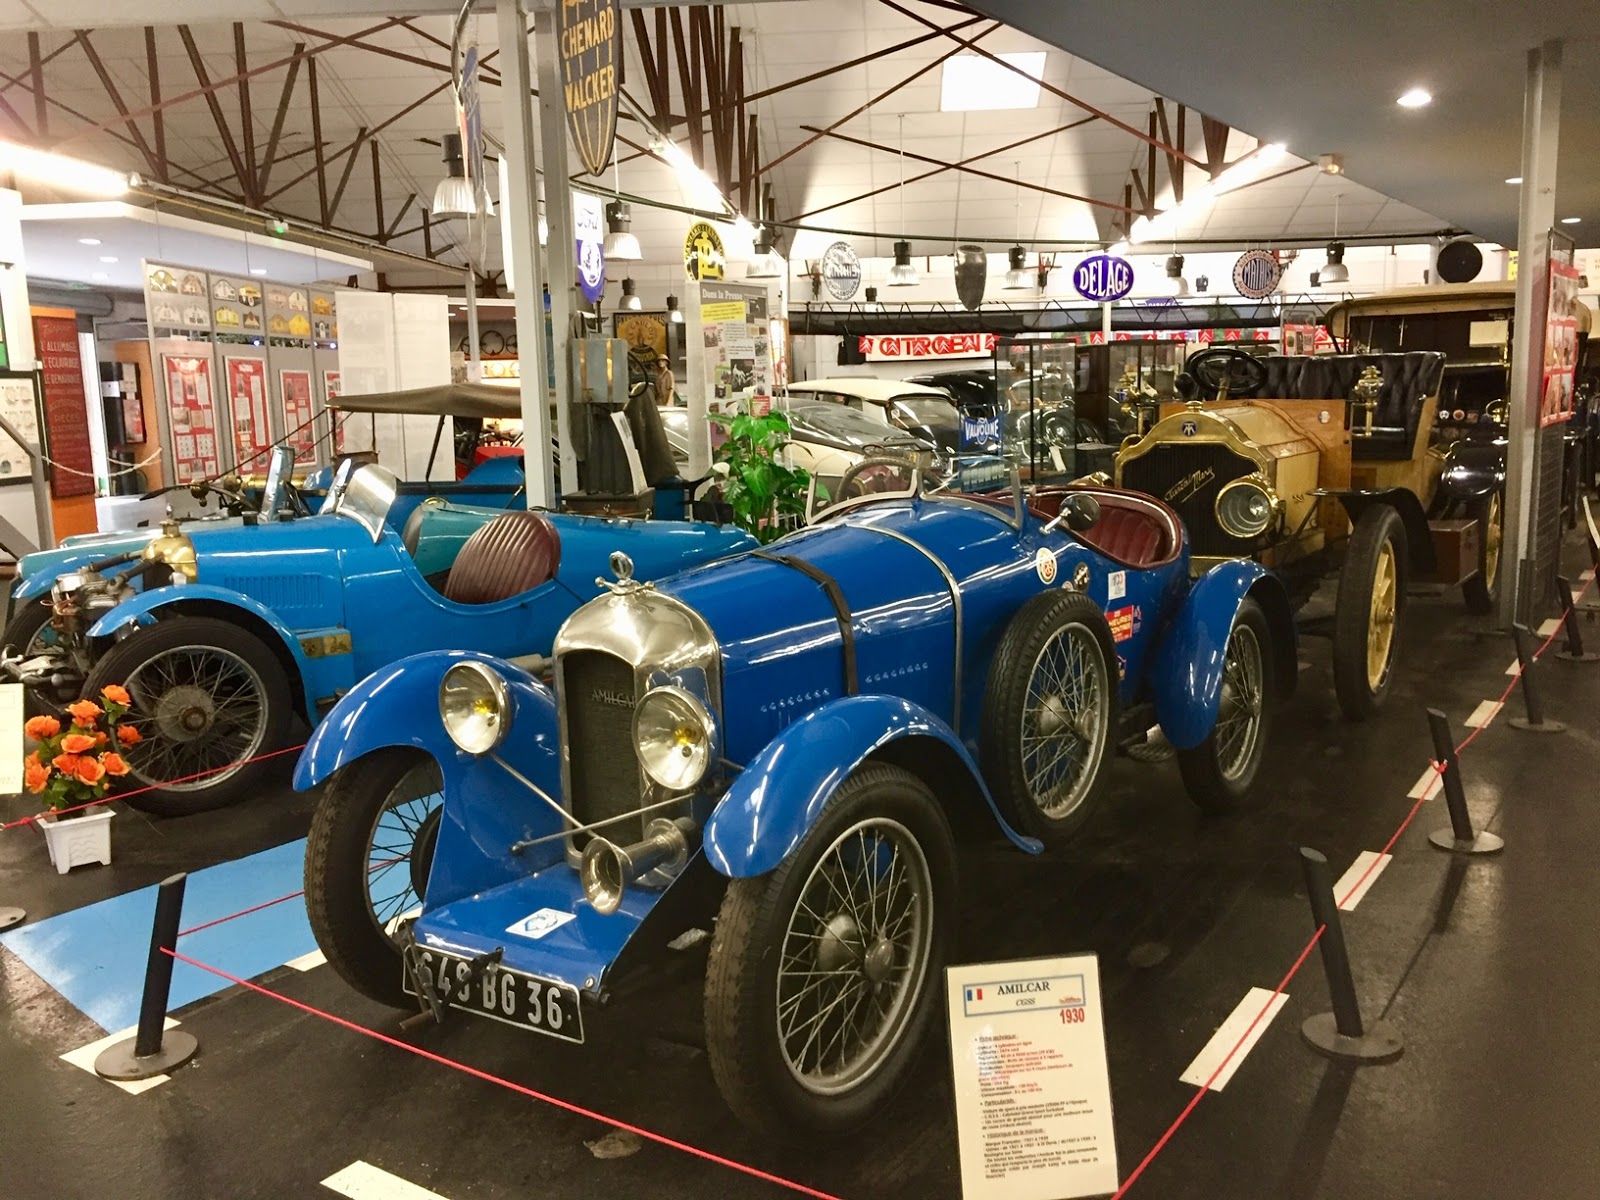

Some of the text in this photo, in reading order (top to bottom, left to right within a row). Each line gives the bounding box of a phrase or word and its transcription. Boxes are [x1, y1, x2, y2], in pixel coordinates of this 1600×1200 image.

[561, 6, 615, 59] CHENARD
[564, 64, 616, 112] WALCKER
[1079, 260, 1129, 297] DELAGE
[527, 981, 562, 1030] 36
[998, 981, 1050, 995] AMILCAR
[1060, 1008, 1085, 1025] 1930
